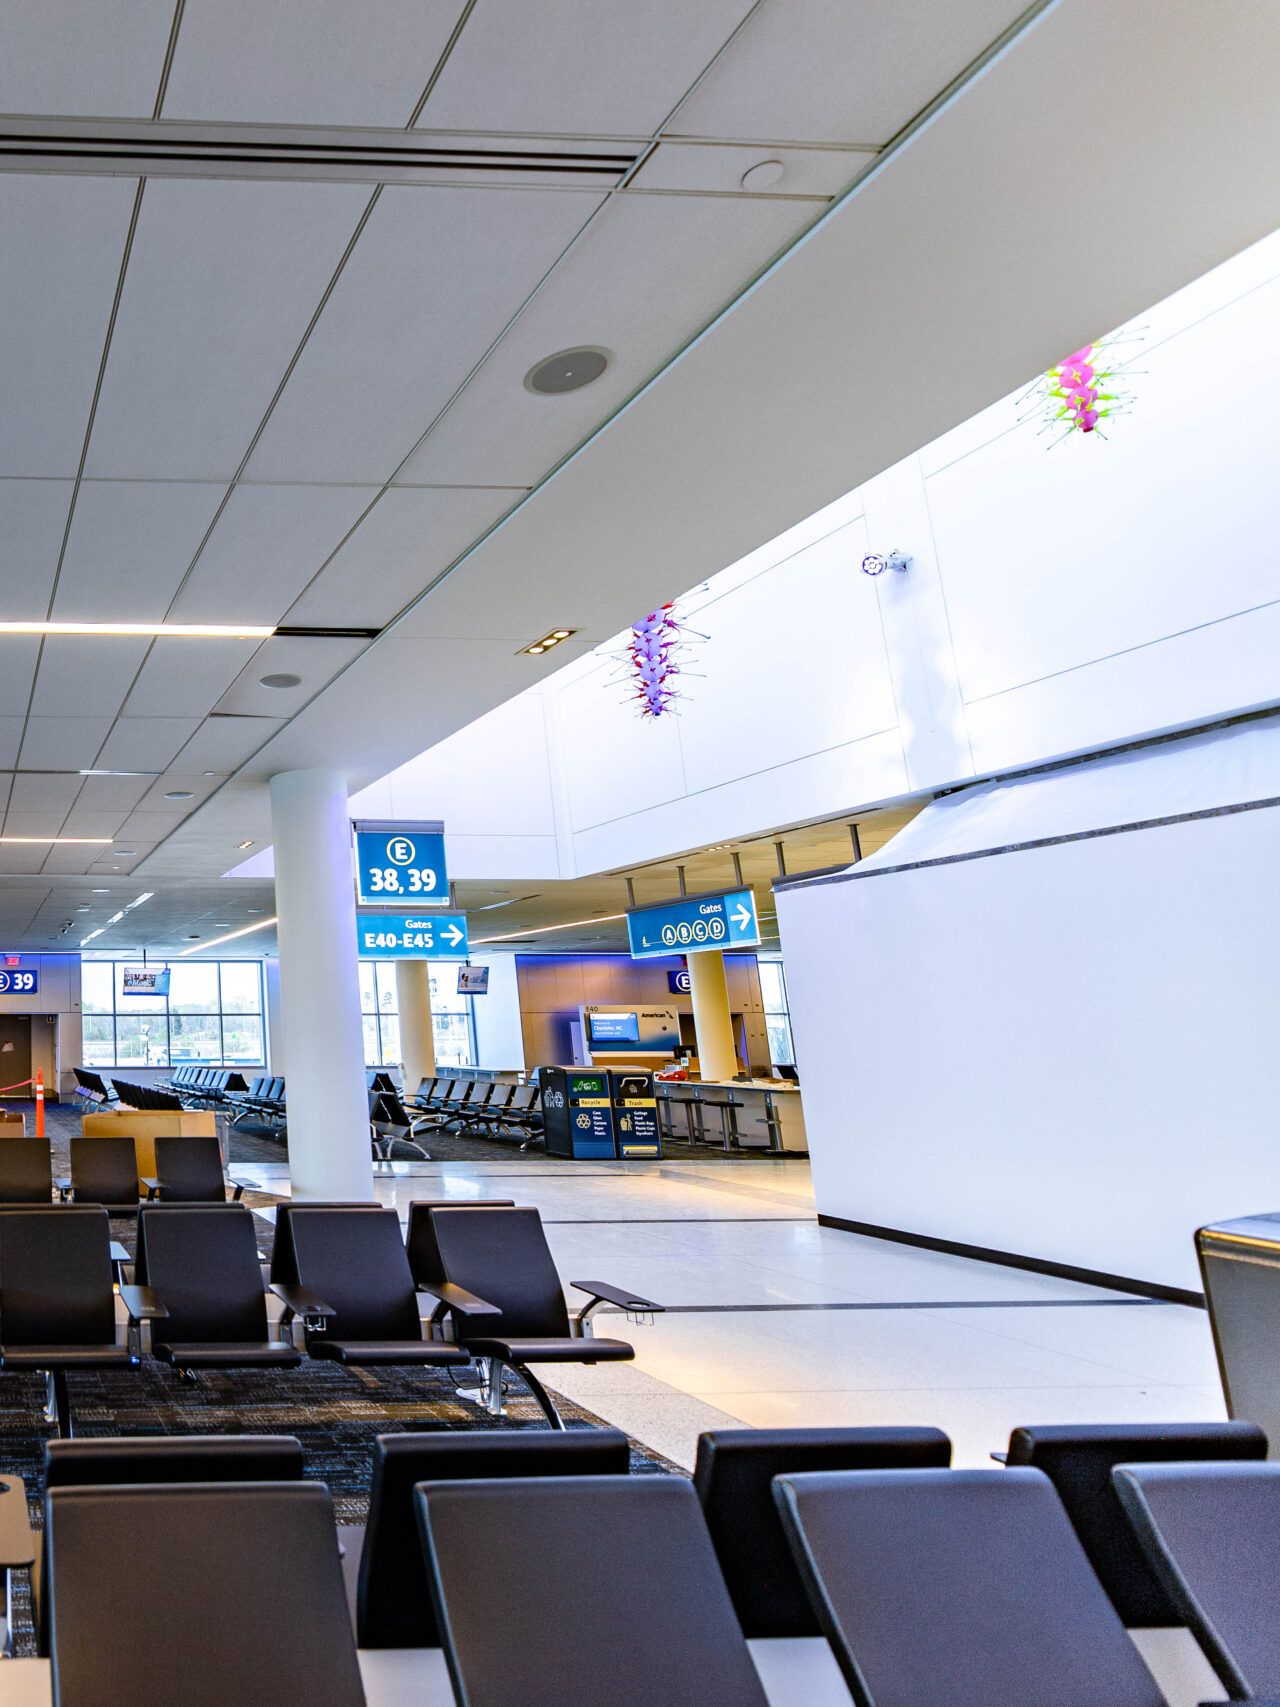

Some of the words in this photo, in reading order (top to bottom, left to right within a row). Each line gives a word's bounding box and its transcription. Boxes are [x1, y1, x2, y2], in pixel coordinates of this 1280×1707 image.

[394, 843, 408, 860] E
[369, 868, 405, 894] 38,
[407, 868, 437, 892] 39
[699, 903, 723, 915] Gates
[405, 919, 433, 929] Gates
[681, 928, 688, 938] B
[696, 925, 704, 936] C
[713, 923, 721, 934] D
[364, 933, 434, 948] E40-E45
[13, 973, 34, 990] 39
[681, 976, 691, 988] E
